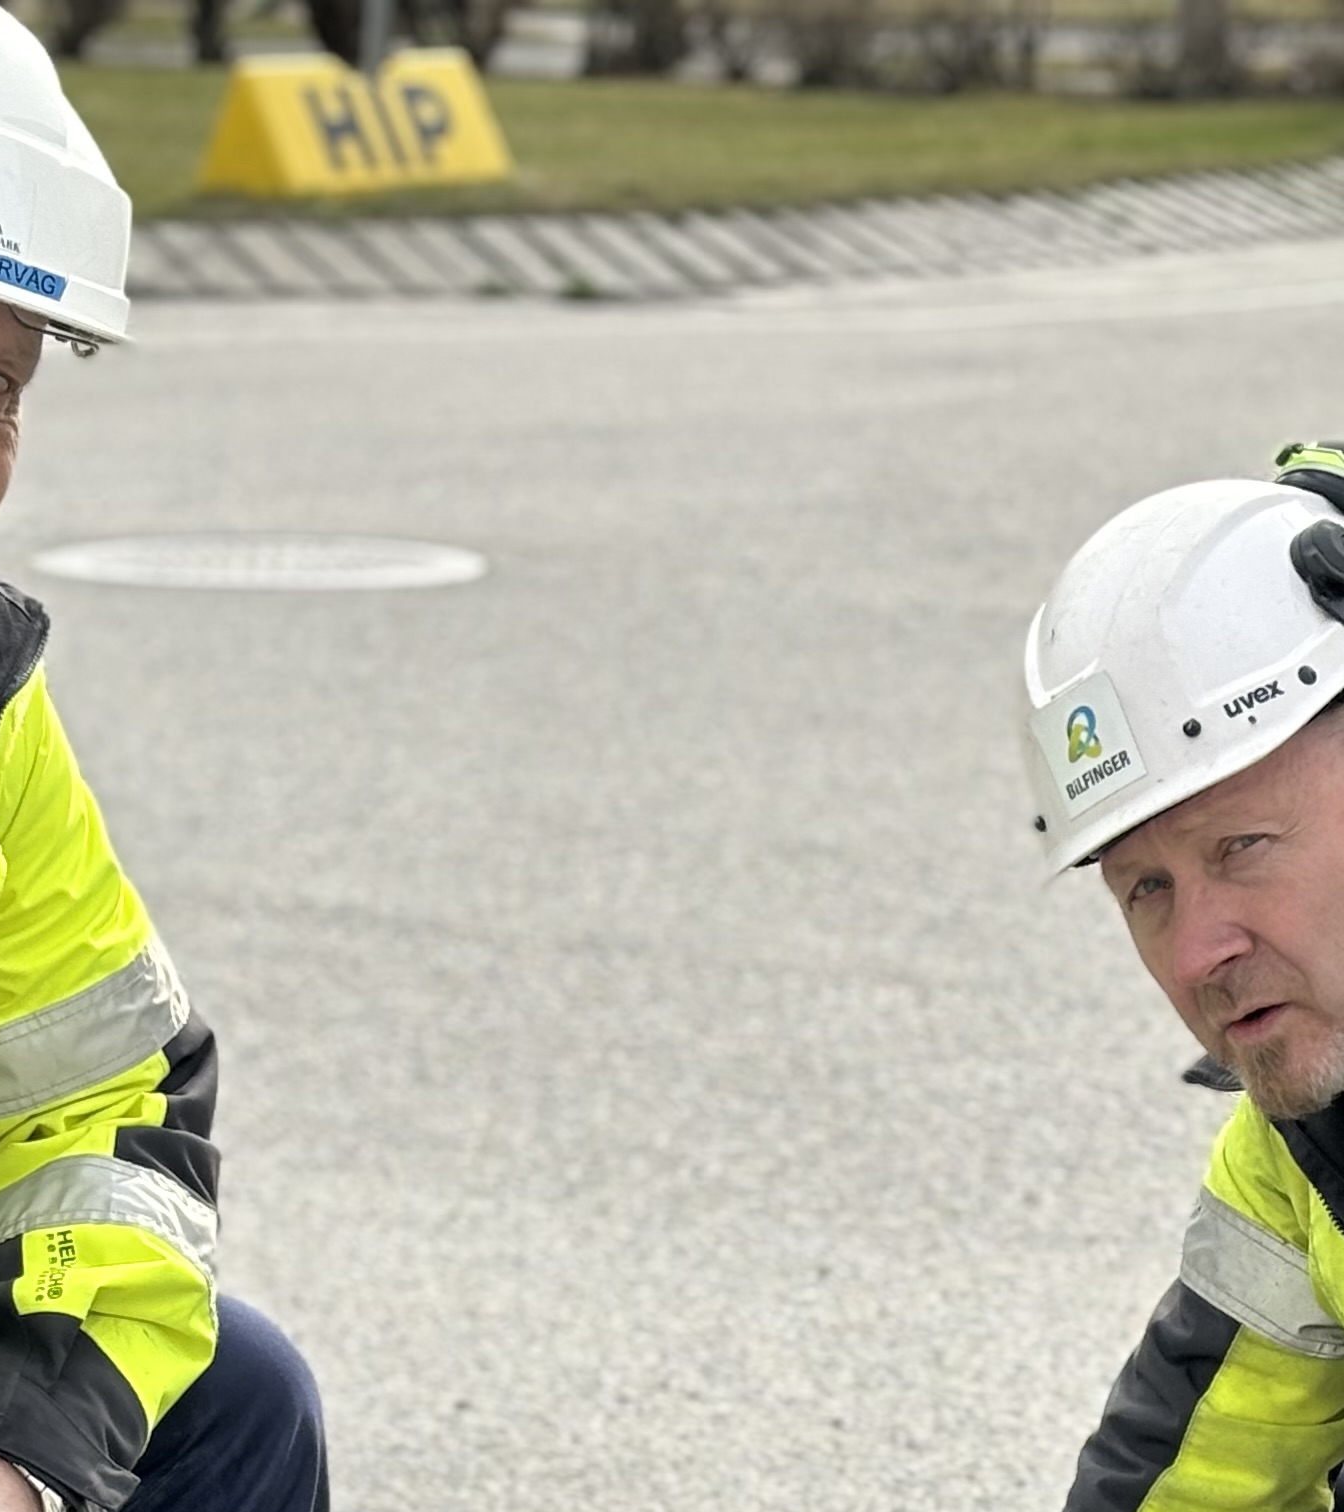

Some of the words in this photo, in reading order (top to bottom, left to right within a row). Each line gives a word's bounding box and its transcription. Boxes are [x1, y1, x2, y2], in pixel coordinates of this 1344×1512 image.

[300, 82, 453, 172] HIP
[1223, 680, 1285, 718] uvex
[1065, 750, 1131, 801] BILFINGER
